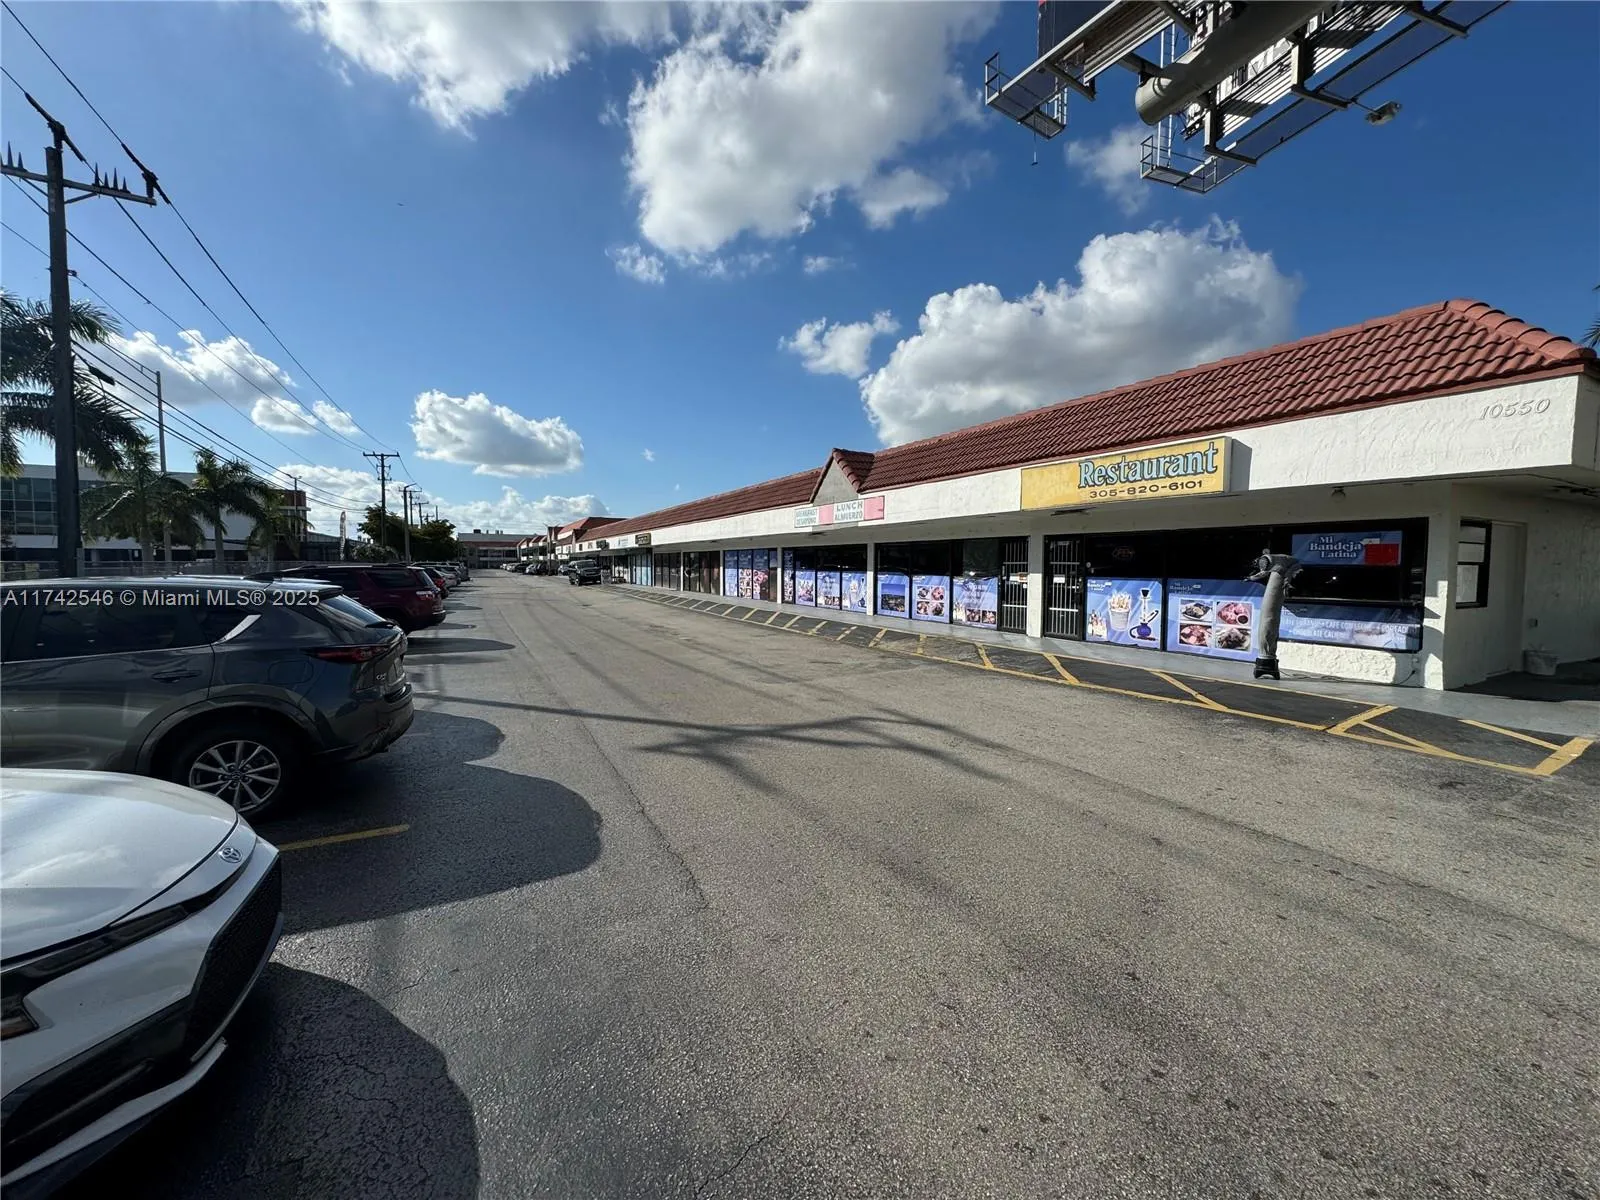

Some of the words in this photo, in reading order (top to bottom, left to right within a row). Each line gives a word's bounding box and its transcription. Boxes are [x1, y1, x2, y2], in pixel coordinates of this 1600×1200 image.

[1480, 399, 1551, 420] 10550
[1078, 442, 1219, 488] Restaurant
[1089, 480, 1203, 498] 305-820-6101
[836, 501, 863, 512] LUNCH
[1309, 542, 1362, 552] Bandeja
